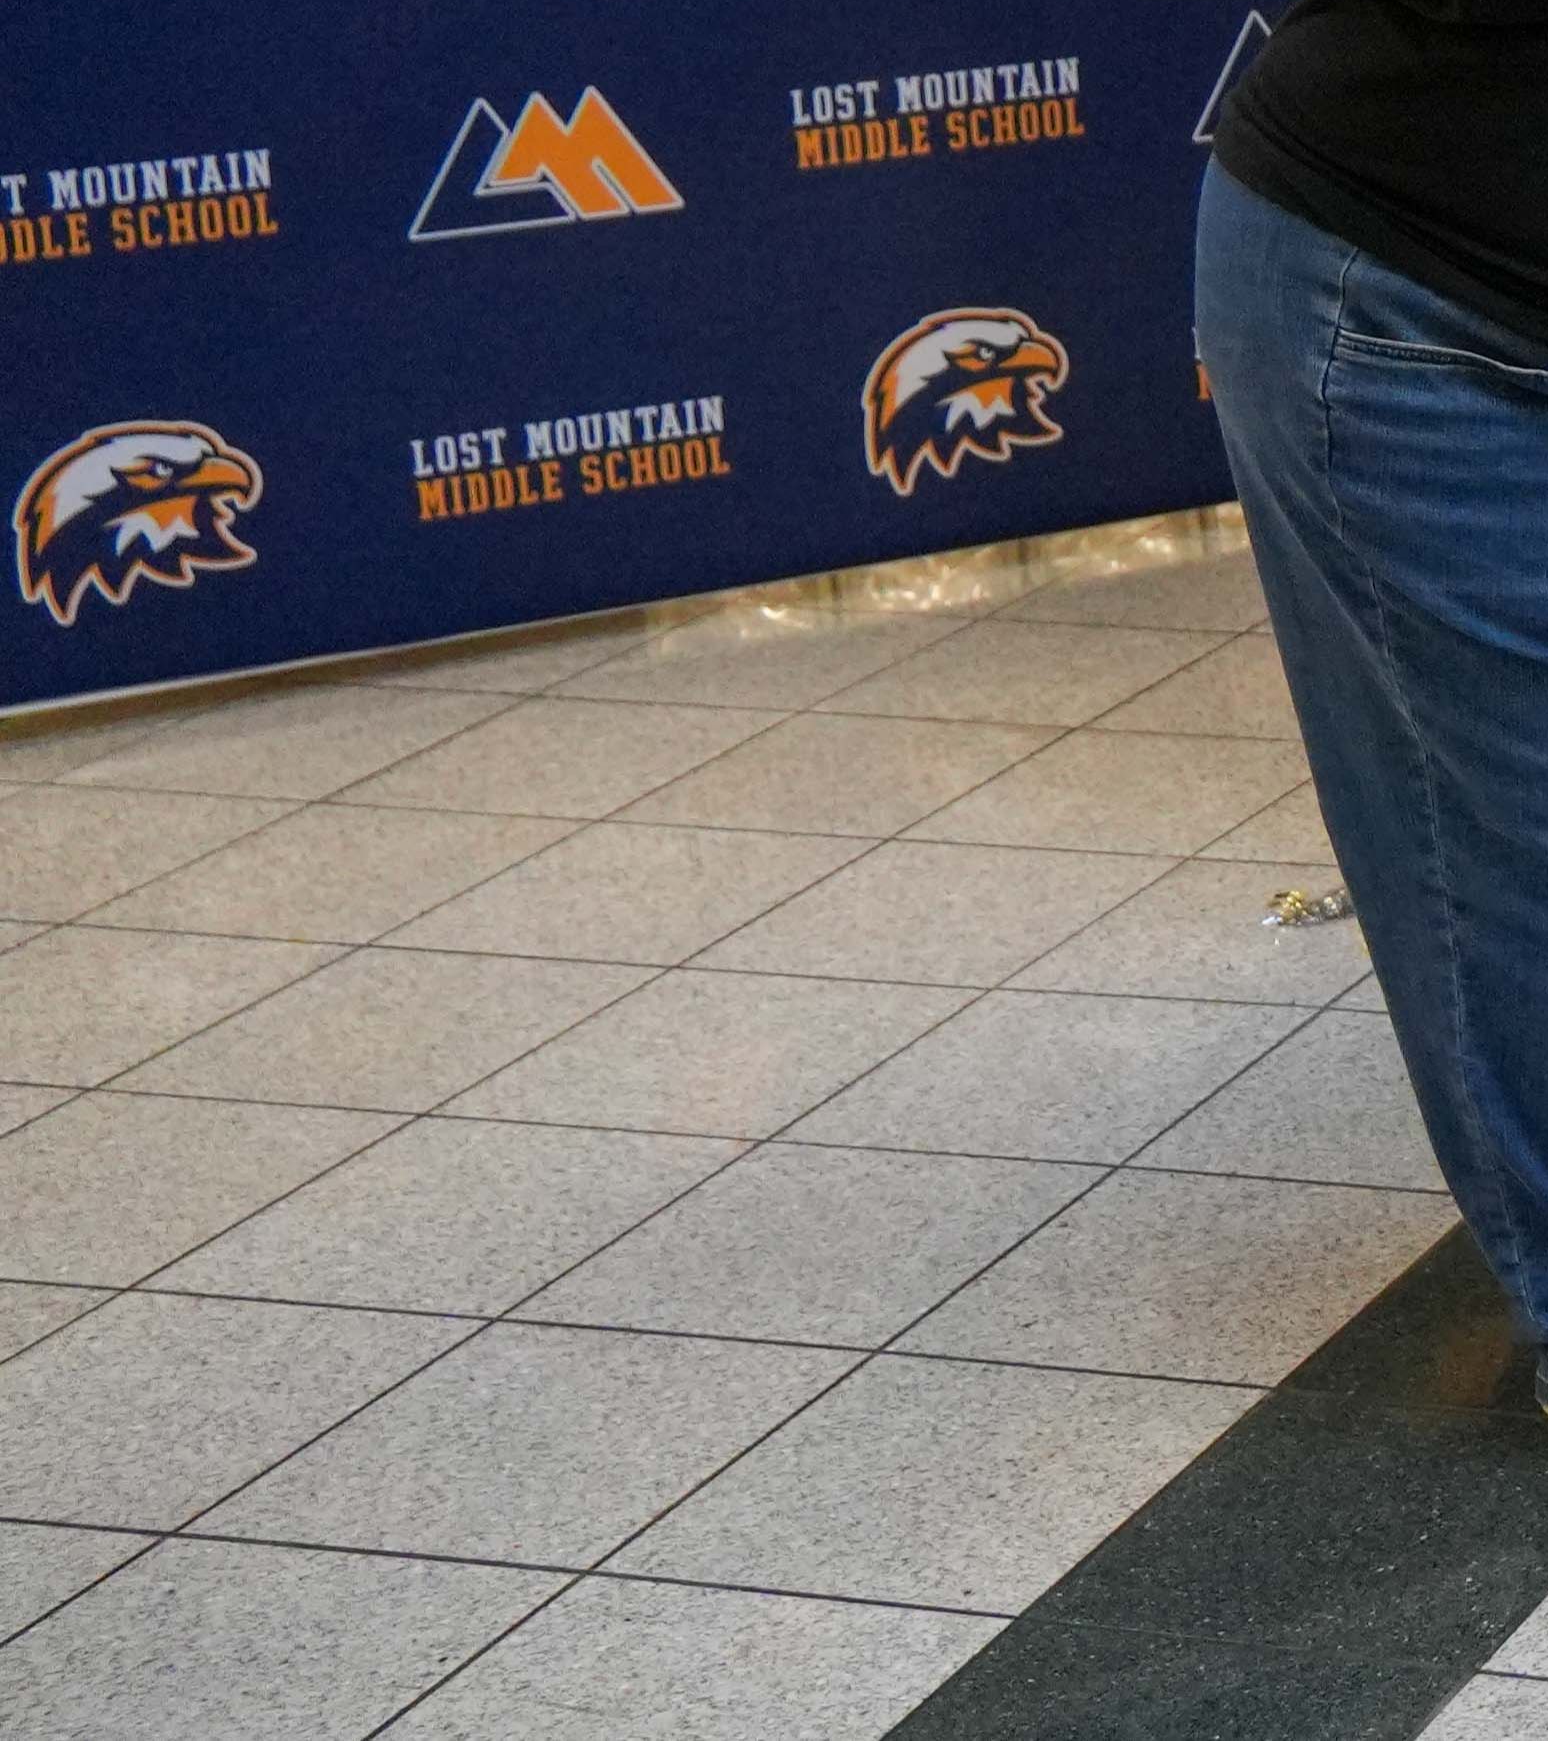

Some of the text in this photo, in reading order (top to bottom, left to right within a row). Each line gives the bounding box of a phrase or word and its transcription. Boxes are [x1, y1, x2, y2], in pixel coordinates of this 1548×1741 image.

[791, 58, 1081, 128] LOST MOUNTAIN
[797, 99, 1085, 170] MIDDLE SCHOOL
[49, 149, 272, 212] MOUNTAIN
[112, 194, 279, 251] SCHOOL
[411, 396, 725, 479] LOST MOUNTAIN
[418, 438, 730, 521] MIDDLE SCHOOL
